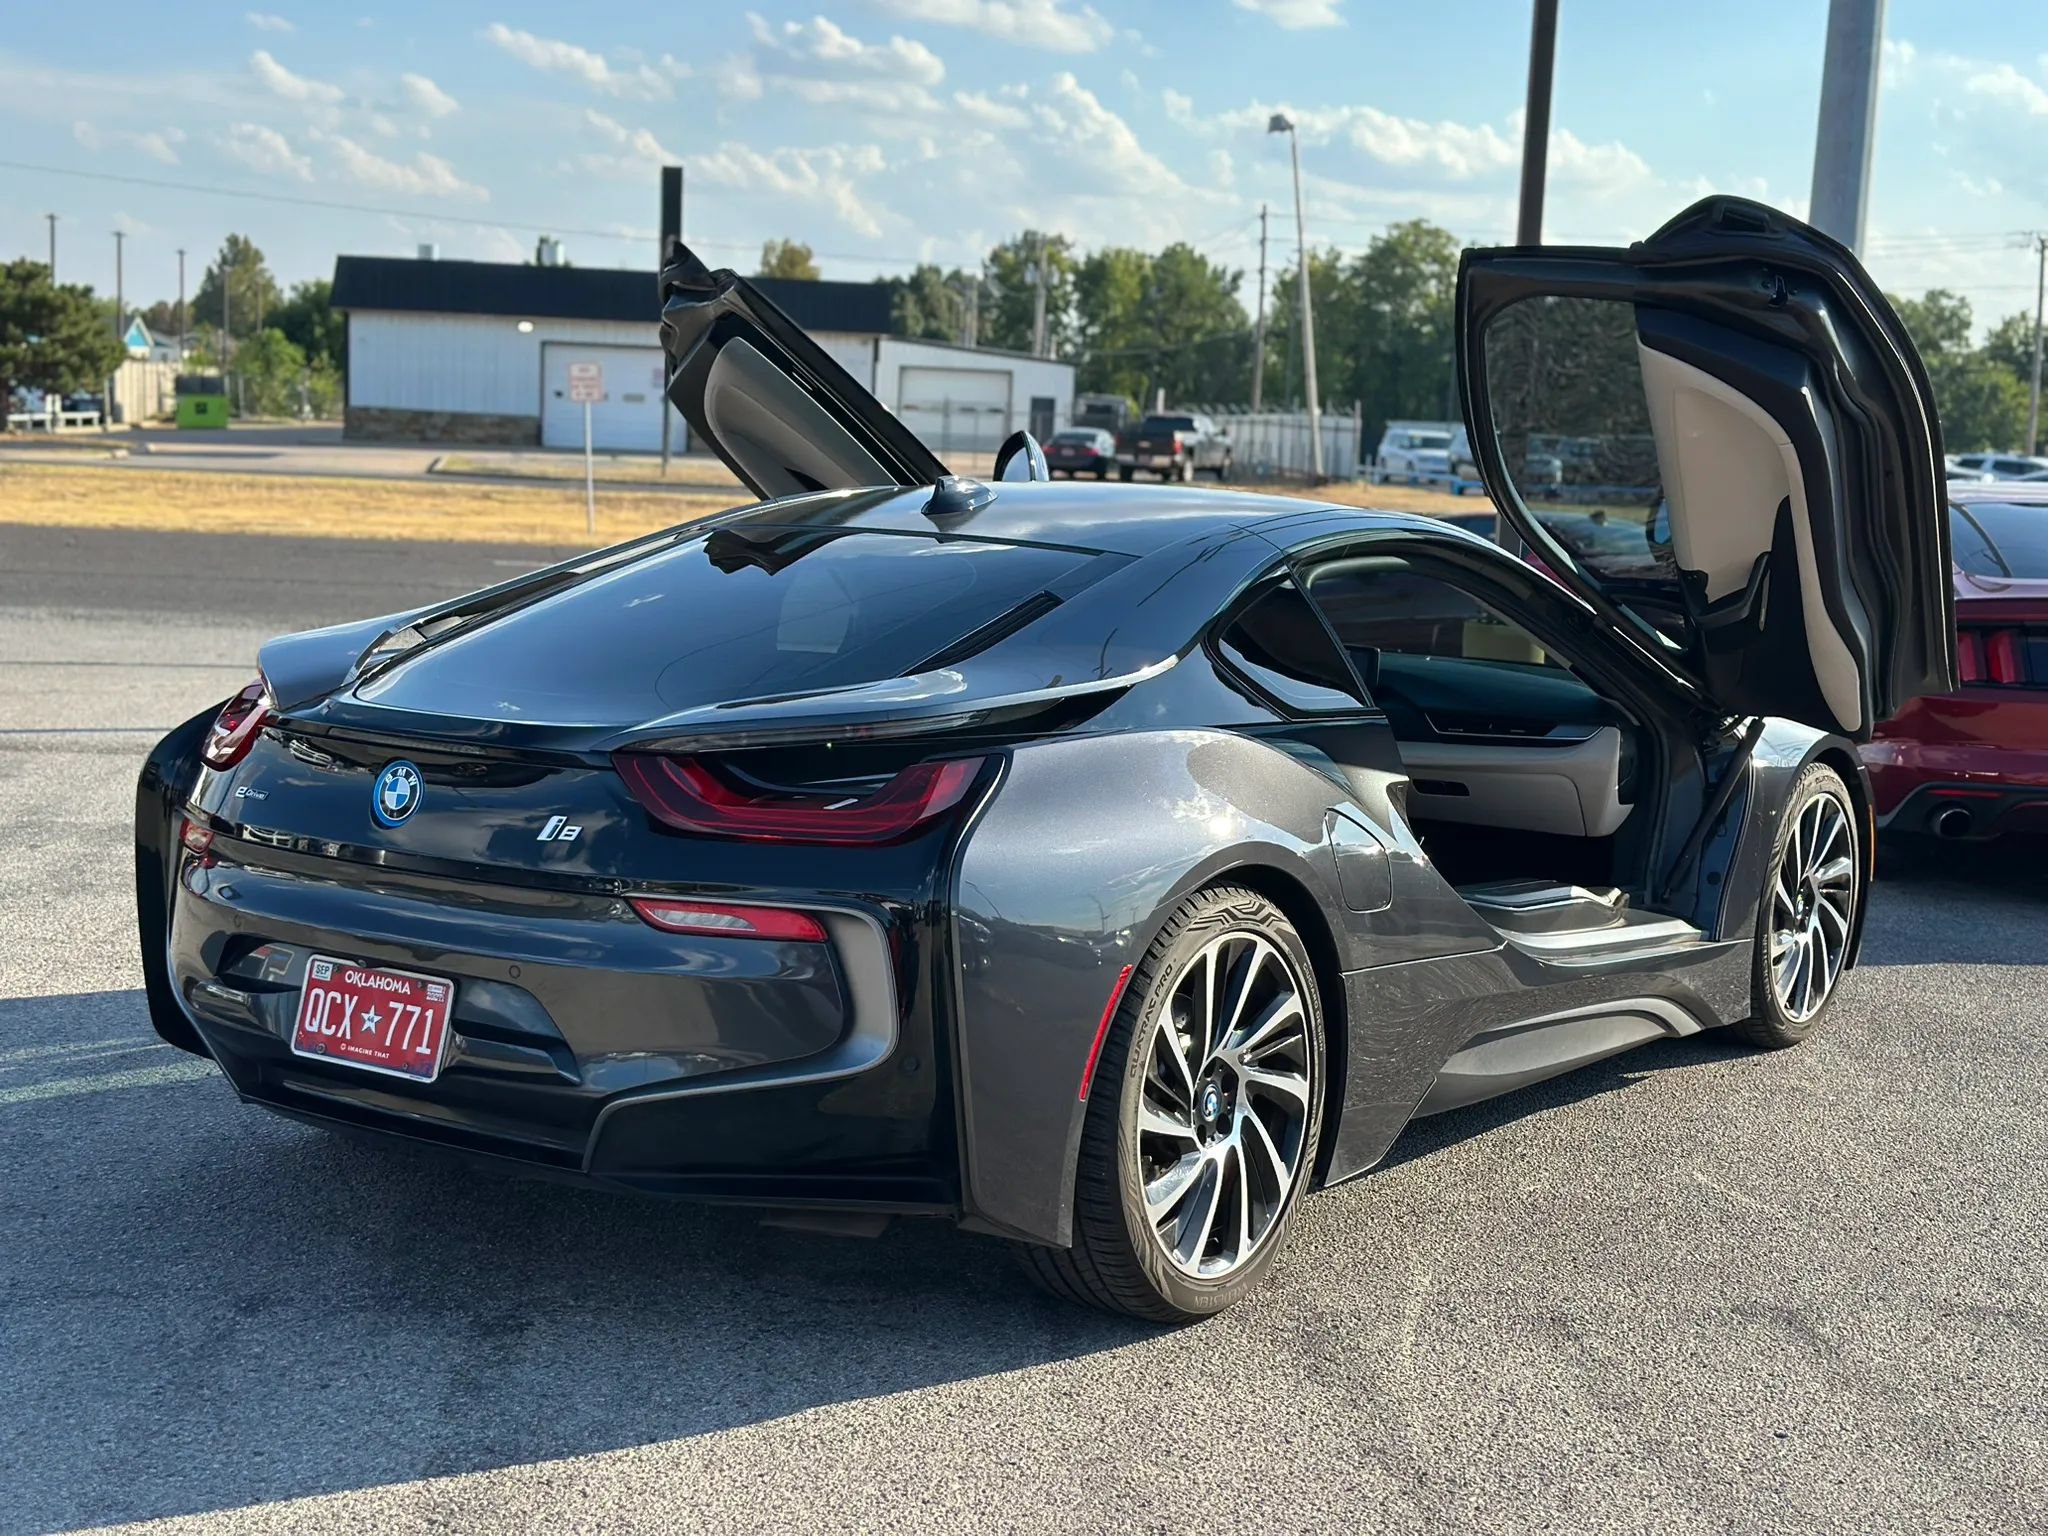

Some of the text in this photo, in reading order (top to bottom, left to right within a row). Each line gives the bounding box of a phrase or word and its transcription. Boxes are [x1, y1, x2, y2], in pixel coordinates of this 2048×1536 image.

[536, 815, 584, 841] i8
[315, 963, 330, 975] SEP
[345, 970, 411, 995] OKLAHOMA
[305, 988, 435, 1055] QCX 771
[1130, 963, 1173, 1079] QUATRAC PRO
[347, 1045, 390, 1059] IMAGINE THAT
